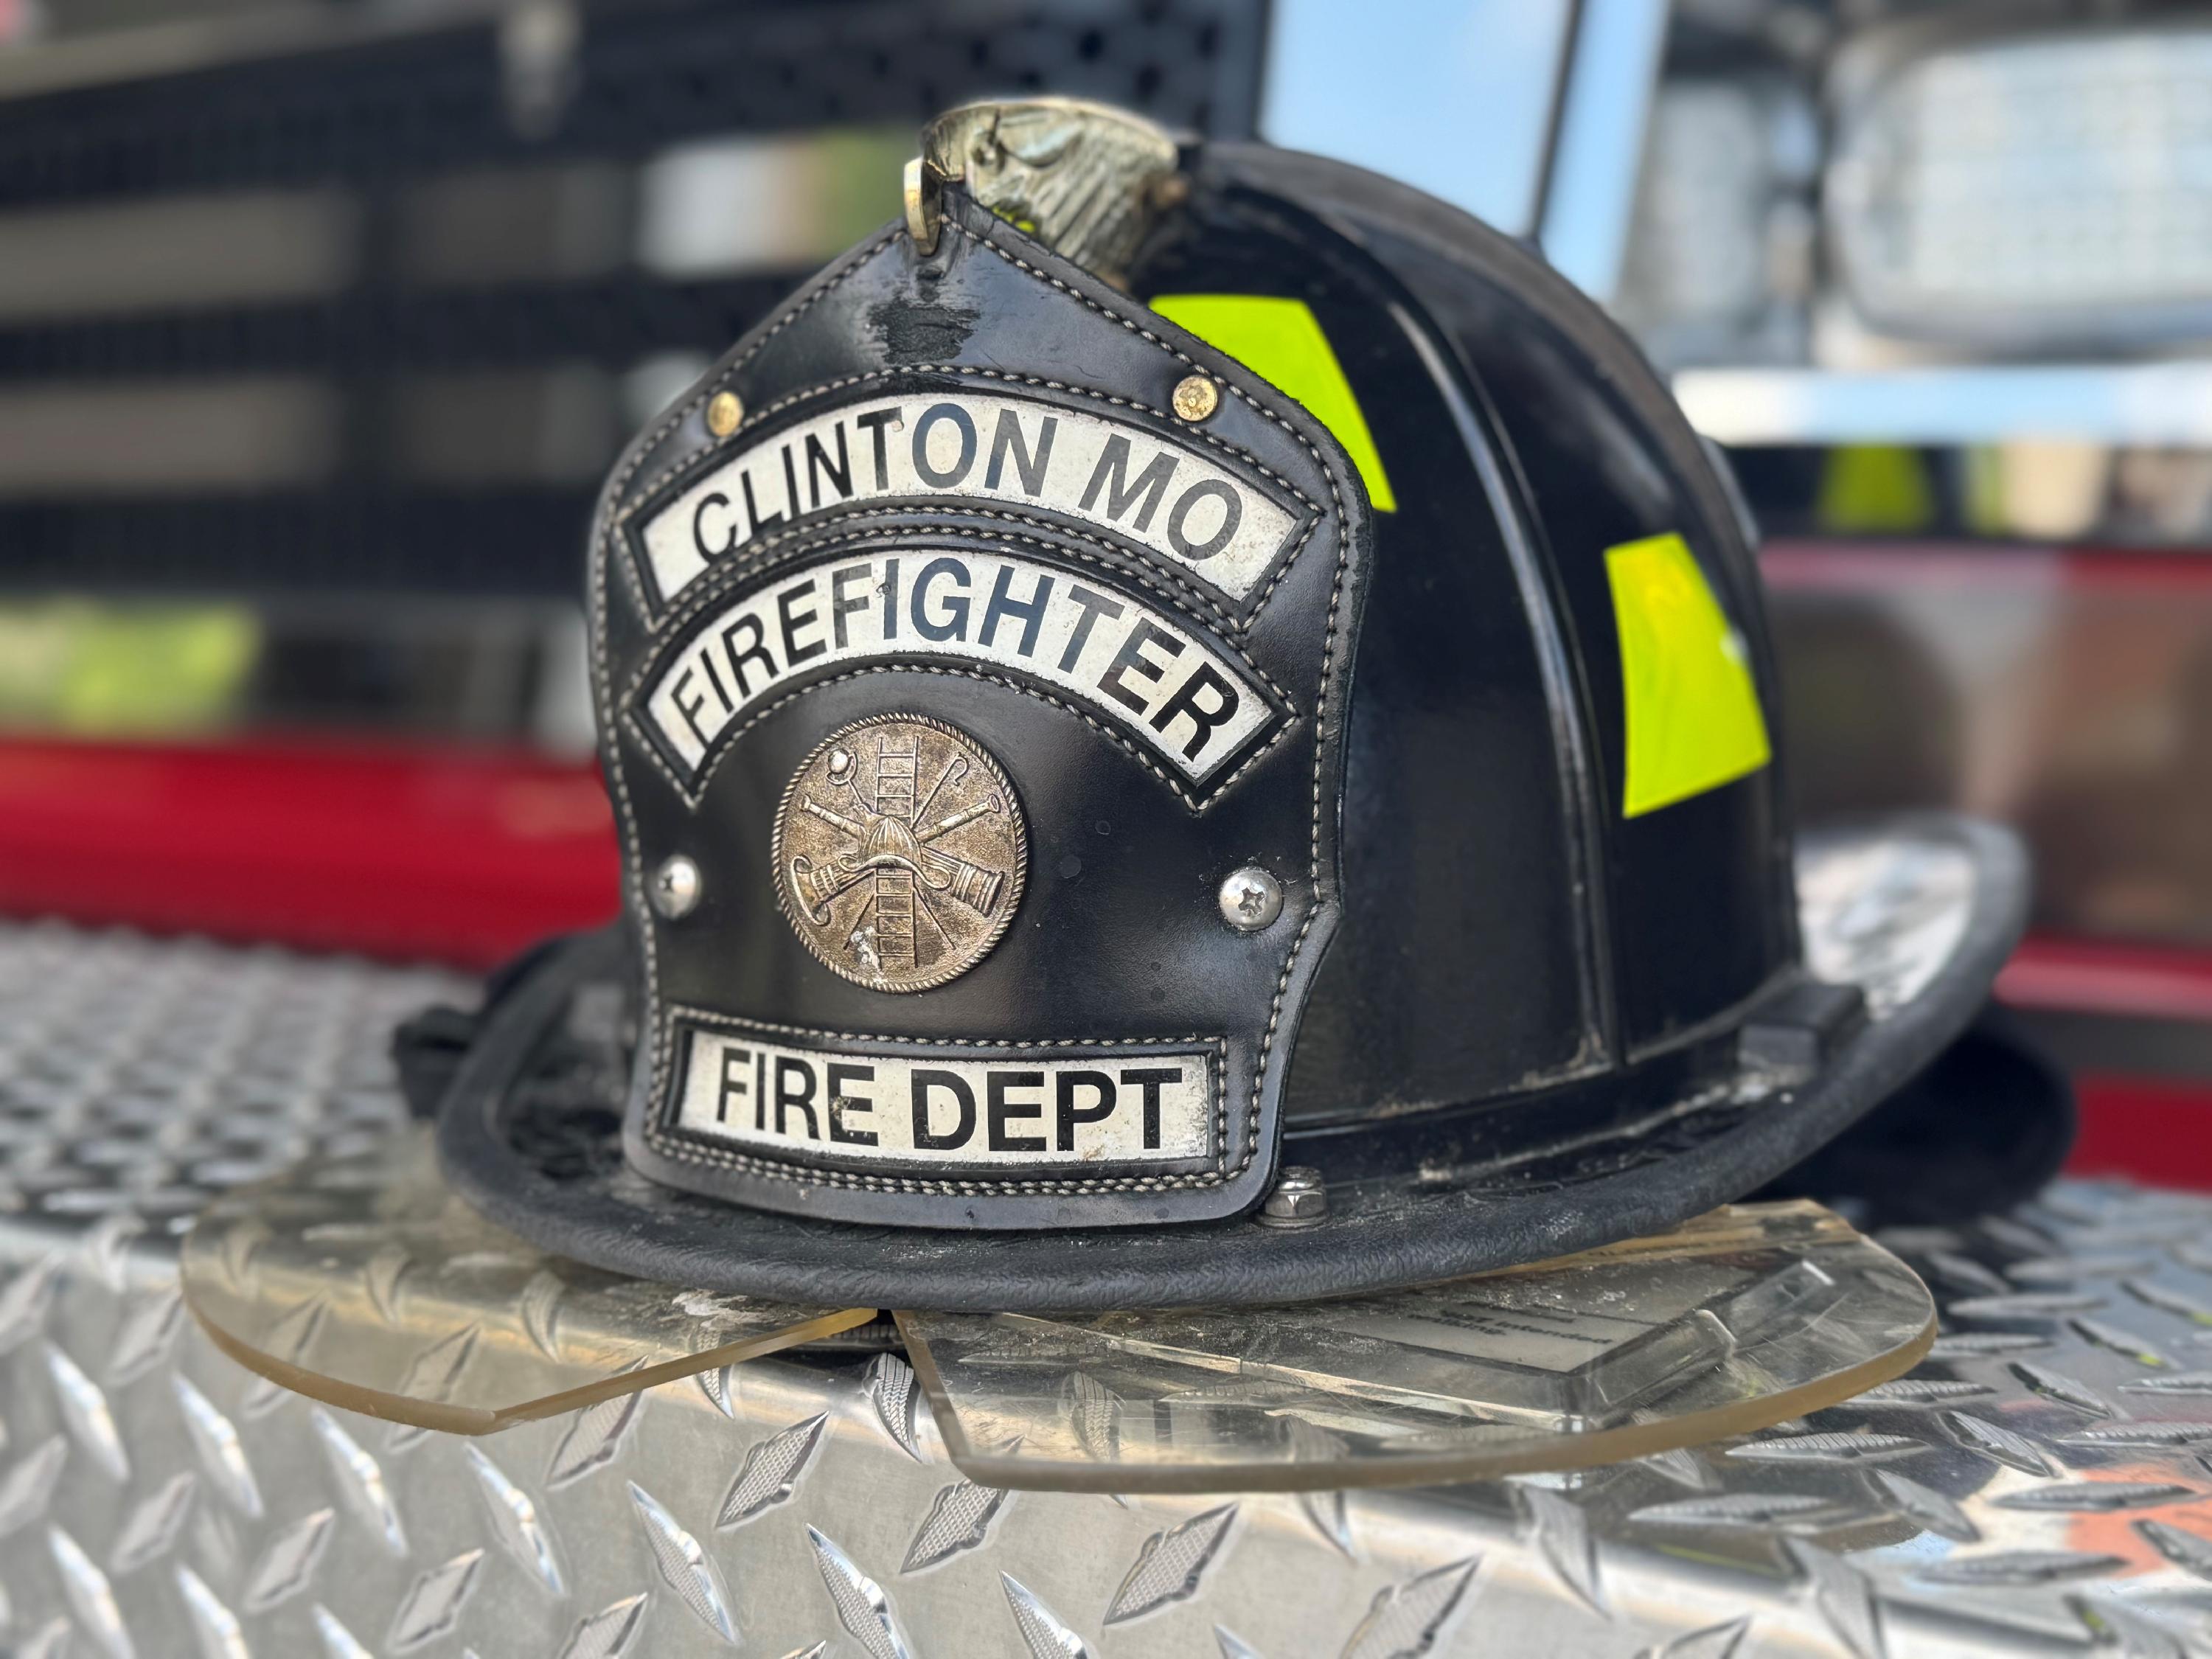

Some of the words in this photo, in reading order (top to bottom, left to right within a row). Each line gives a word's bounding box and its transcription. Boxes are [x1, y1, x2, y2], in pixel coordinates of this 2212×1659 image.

[692, 402, 1057, 565] CLINTON
[1077, 434, 1242, 561] MO
[670, 557, 1241, 763] FIREFIGHTER
[717, 1046, 879, 1147] FIRE
[910, 1068, 1181, 1152] DEPT
